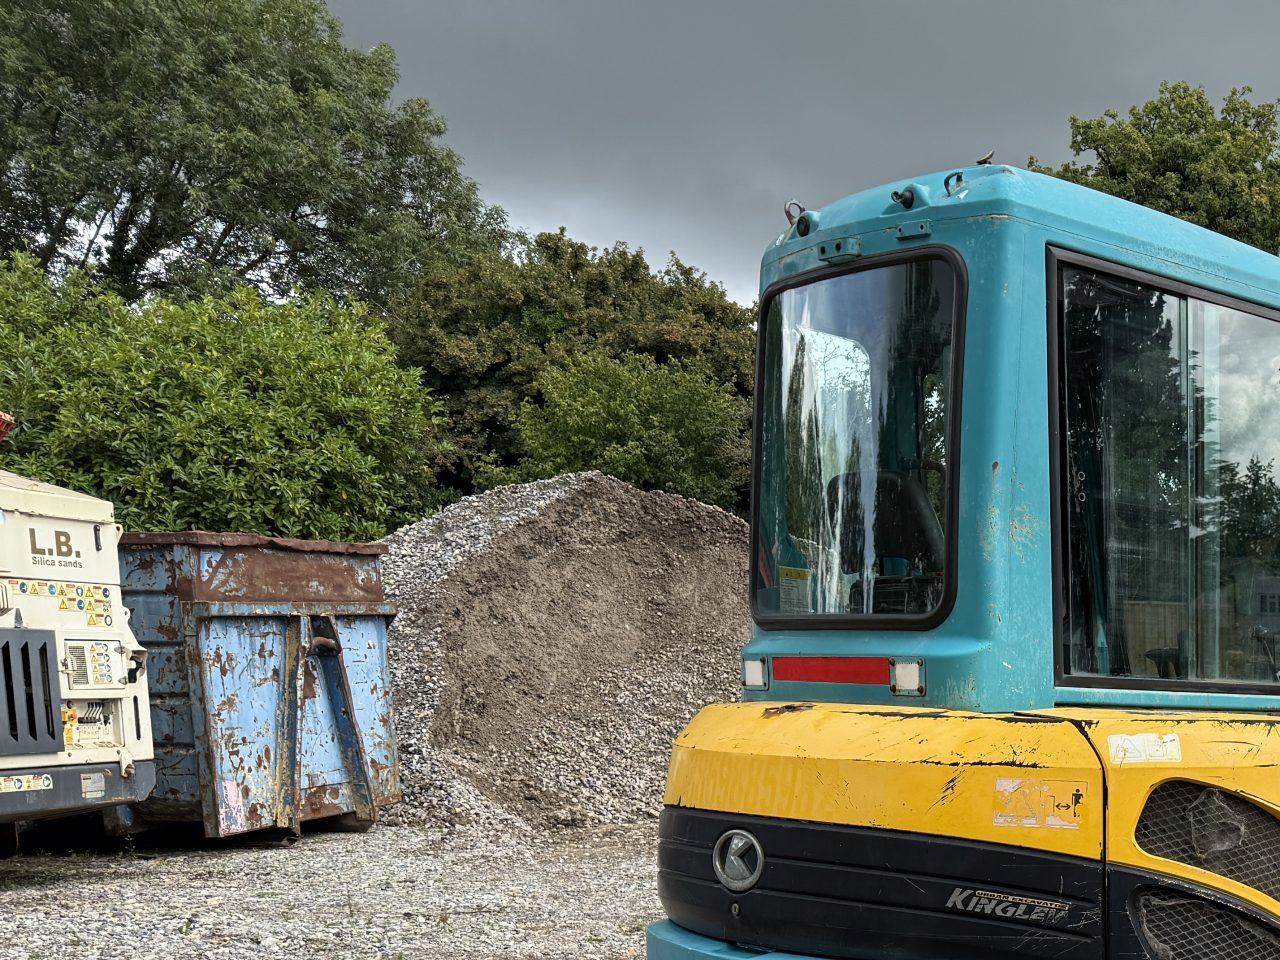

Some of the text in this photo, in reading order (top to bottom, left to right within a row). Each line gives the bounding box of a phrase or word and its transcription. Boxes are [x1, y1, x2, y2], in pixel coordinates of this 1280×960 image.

[28, 527, 81, 558] L.B.
[31, 556, 83, 568] Silica sands
[976, 890, 1010, 901] URBAN
